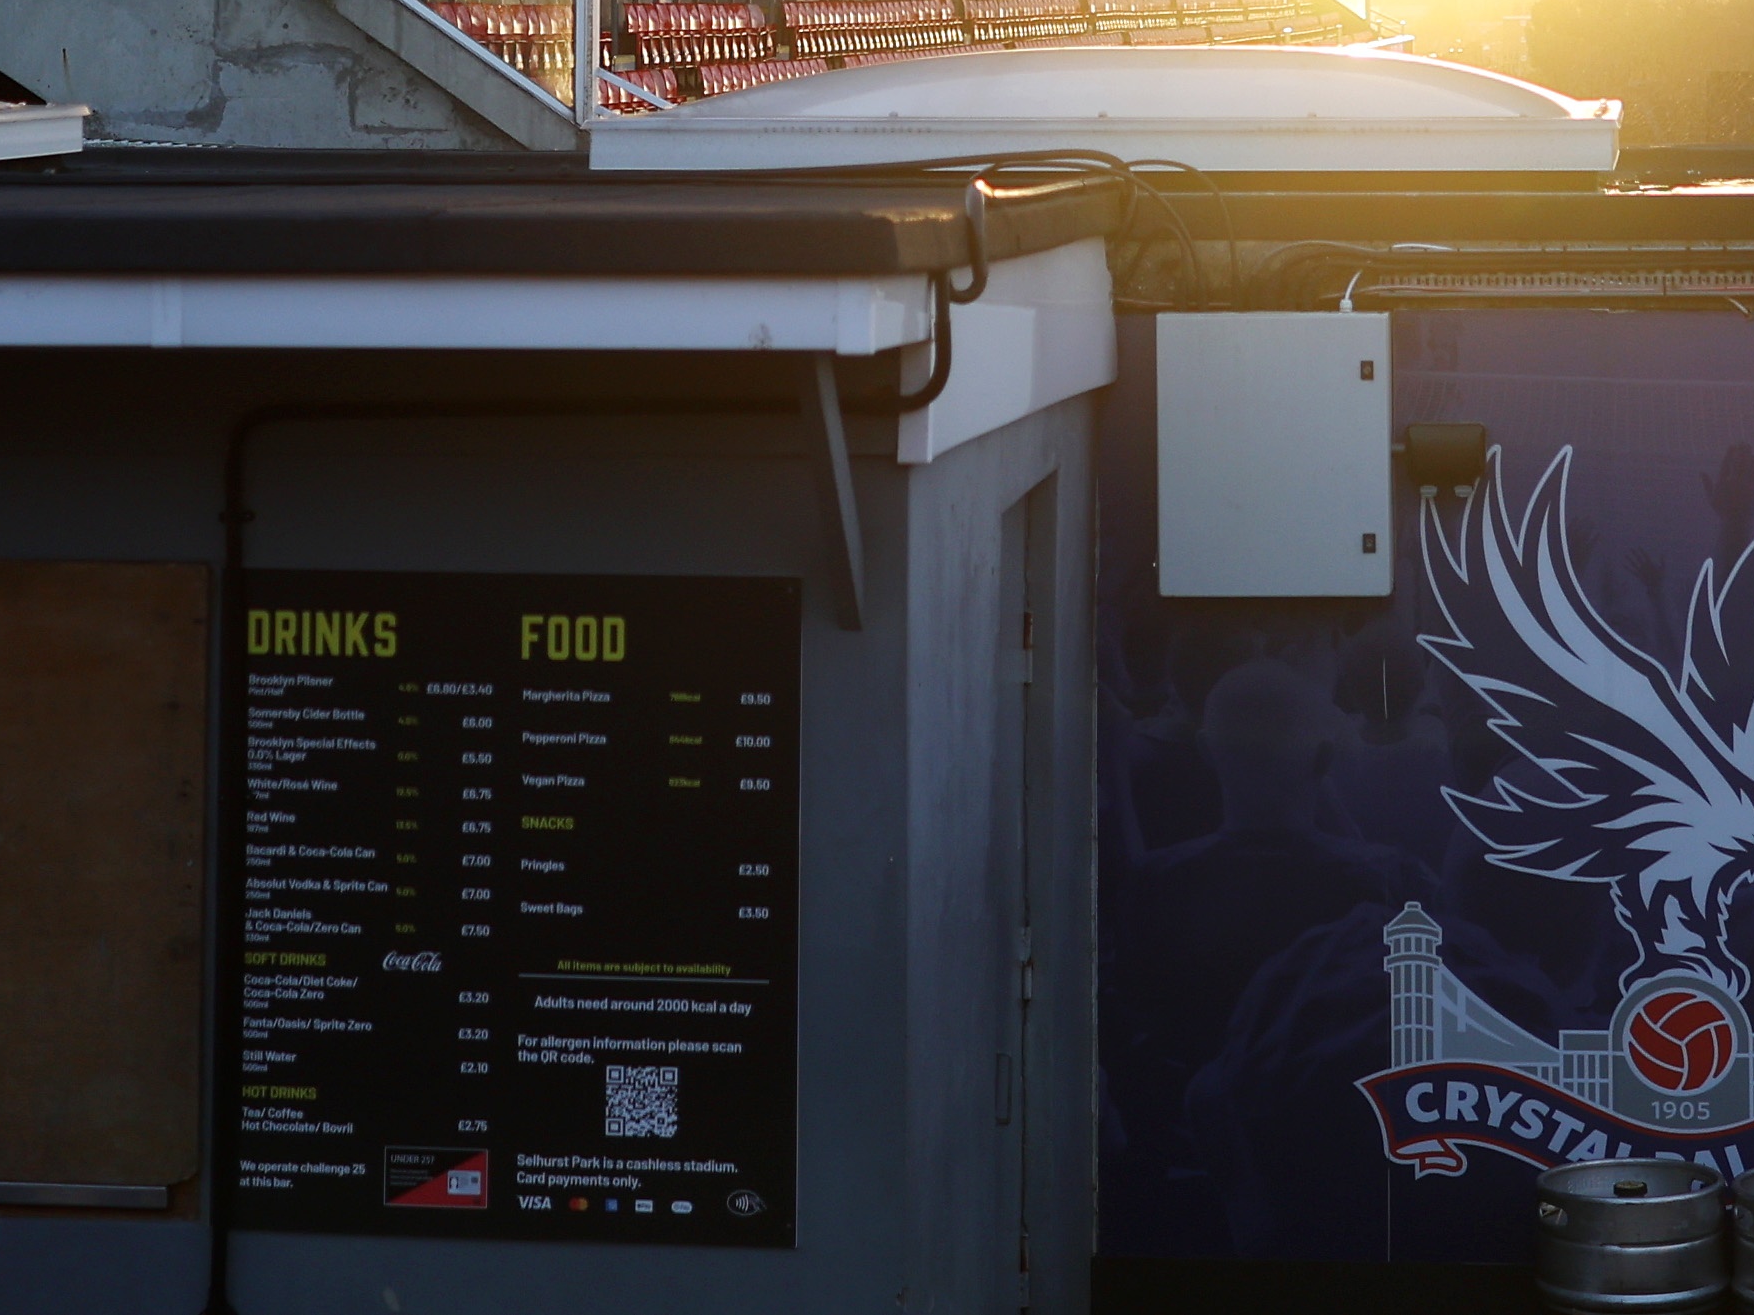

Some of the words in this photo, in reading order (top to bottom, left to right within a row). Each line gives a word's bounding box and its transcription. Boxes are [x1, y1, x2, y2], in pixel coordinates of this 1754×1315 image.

[248, 610, 396, 657] DRINKS
[521, 615, 625, 661] FOOD
[249, 674, 295, 688] Brooklyn
[296, 674, 333, 686] Pilsner
[522, 689, 581, 703] Margherita
[582, 690, 610, 702] Pizza
[248, 707, 301, 721] Somersby
[302, 708, 331, 719] Cider
[332, 708, 365, 720] Bottle
[248, 736, 294, 751] Brooklyn
[295, 737, 335, 750] Special
[336, 738, 376, 750] Effects
[522, 732, 576, 745] Pepperoni
[578, 733, 606, 744] Pizza
[735, 736, 770, 747] £10.00
[247, 750, 273, 760] 0.0%
[275, 750, 307, 763] Lager
[247, 778, 309, 790] White/Rosé
[310, 780, 338, 791] Wine
[522, 774, 555, 788] Vegan
[556, 774, 585, 786] Pizza
[462, 788, 492, 799] £6.75
[246, 811, 267, 822] Red
[269, 811, 296, 823] Wine
[521, 816, 573, 830] SNACKS
[461, 821, 491, 833] £6.75
[246, 844, 286, 856] Bacardi
[298, 845, 353, 858] Coca-Cola
[354, 846, 375, 858] Can
[462, 855, 491, 866] £7.00
[521, 859, 565, 873] Pringles
[738, 864, 769, 876] £2.50
[245, 878, 286, 890] Absolut
[288, 879, 321, 890] Vodka
[333, 880, 366, 893] Sprite
[367, 881, 388, 892] Can
[461, 888, 490, 899] £7.00
[245, 908, 271, 918] Jack
[273, 909, 312, 920] Daniels
[520, 901, 554, 913] Sweet
[556, 902, 583, 916] Bags
[738, 907, 769, 919] £3.50
[255, 921, 339, 934] Coca-Cola/Zero
[340, 923, 361, 934] Can
[244, 952, 277, 964] SOFT
[279, 952, 326, 966] DRINKS
[557, 960, 571, 970] All
[572, 960, 602, 971] items
[603, 963, 620, 971] are
[622, 962, 661, 974] subject
[675, 963, 731, 977] availability
[244, 974, 324, 987] Coca-Cola/Diet
[326, 976, 358, 988] Coke/
[243, 988, 299, 999] Coca-Cola
[299, 988, 325, 999] Zero
[458, 992, 489, 1003] £3.20
[534, 995, 575, 1009] Adults
[577, 997, 608, 1010] need
[610, 998, 654, 1011] around
[656, 999, 689, 1012] 2000
[691, 1000, 717, 1013] kcal
[729, 1001, 752, 1016] day
[243, 1017, 311, 1031] Fanta/Oasis/
[313, 1019, 346, 1032] Sprite
[347, 1020, 372, 1031] Zero
[458, 1028, 488, 1040] £3.20
[517, 1034, 538, 1047] For
[540, 1035, 590, 1051] allergen
[592, 1036, 666, 1051] information
[668, 1039, 709, 1053] please
[712, 1042, 742, 1053] scan
[243, 1050, 263, 1061] Still
[265, 1051, 297, 1062] Water
[517, 1050, 538, 1062] the
[540, 1050, 558, 1064] QR
[560, 1051, 594, 1064] code.
[460, 1062, 488, 1074] £2.10
[242, 1085, 267, 1098] HOT
[270, 1085, 316, 1100] DRINKS
[243, 1106, 266, 1118] Tea/
[267, 1107, 304, 1119] Coffee
[1651, 1100, 1711, 1121] 1905
[241, 1120, 260, 1130] Hot
[261, 1121, 321, 1132] Chocolate/
[322, 1122, 353, 1134] Bovril
[457, 1119, 487, 1131] £2.75
[240, 1160, 256, 1171] We
[257, 1162, 299, 1173] operate
[300, 1162, 351, 1176] challenge
[352, 1163, 366, 1175] 25
[517, 1154, 569, 1167] Selhurst
[571, 1155, 600, 1169] Park
[626, 1158, 681, 1171] cashless
[683, 1159, 738, 1173] stadium.
[252, 1177, 272, 1187] this
[273, 1177, 293, 1188] bar.
[516, 1172, 545, 1184] Card
[548, 1174, 610, 1188] payments
[612, 1175, 641, 1190] only.
[518, 1195, 551, 1209] VISA
